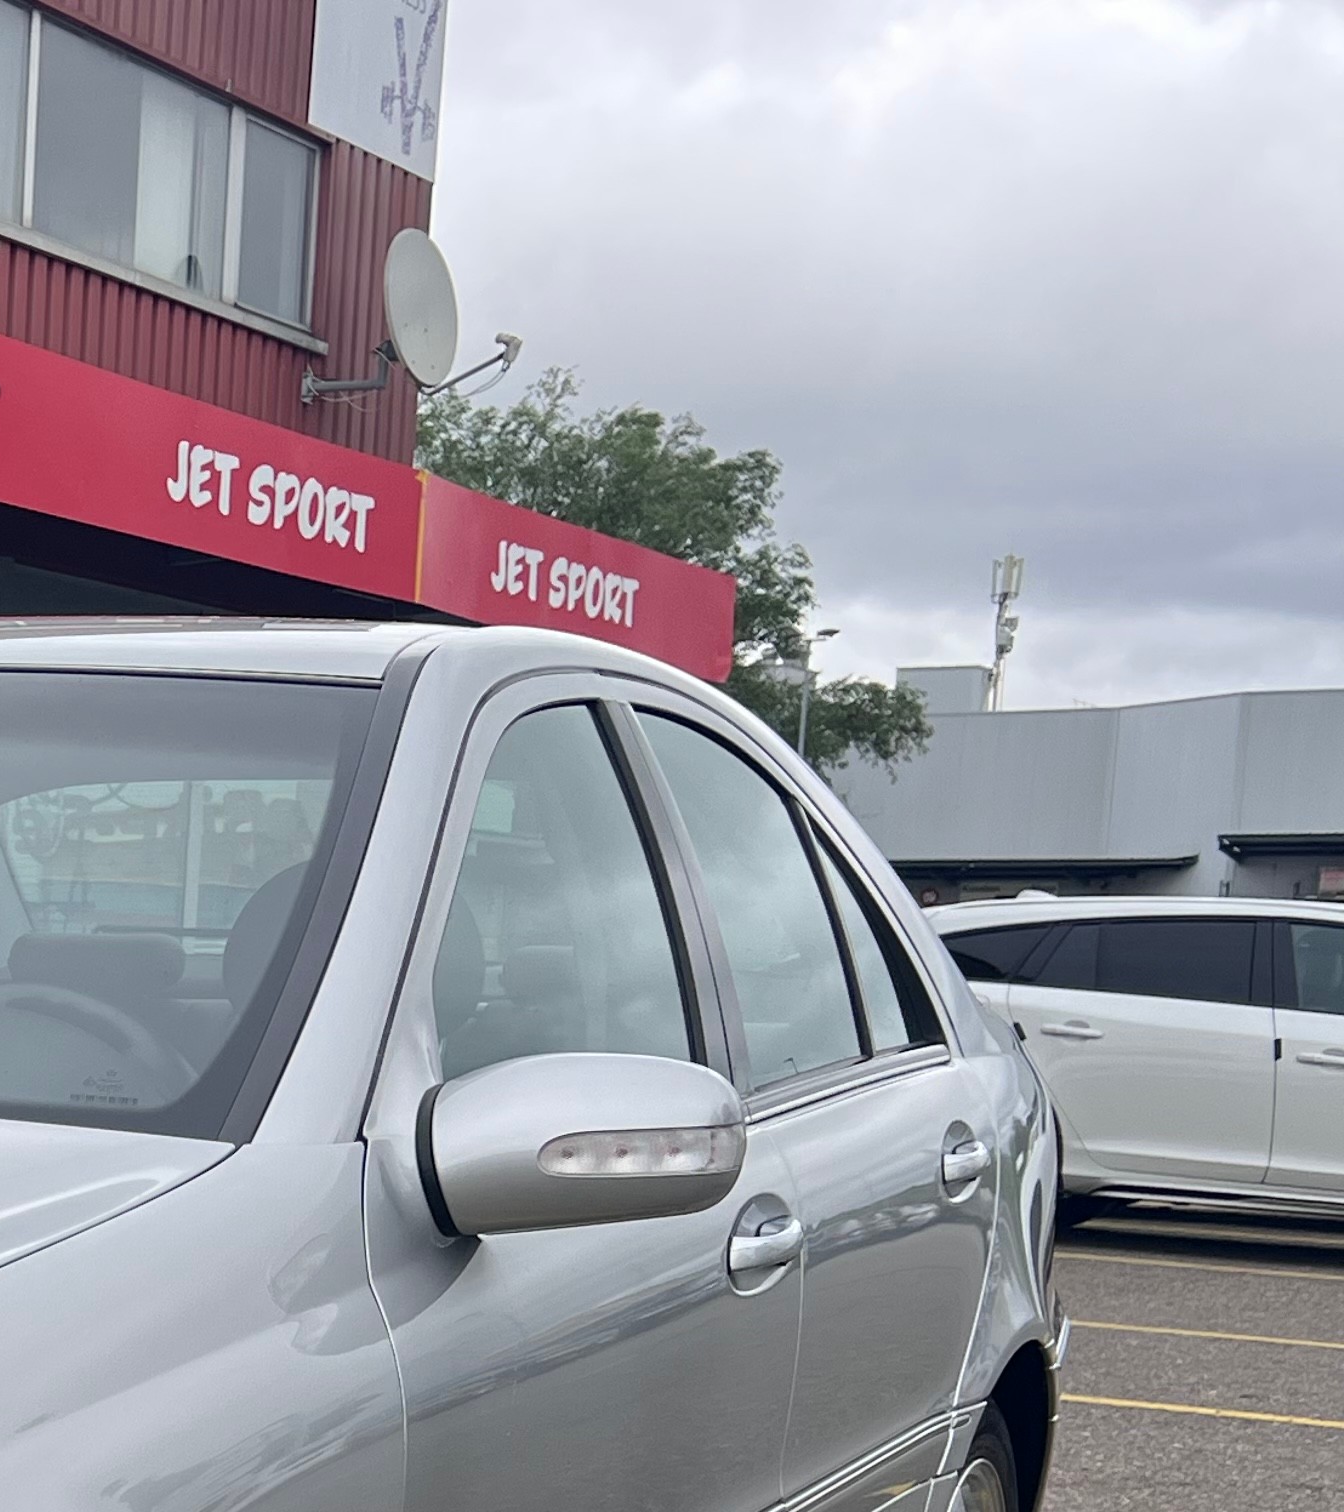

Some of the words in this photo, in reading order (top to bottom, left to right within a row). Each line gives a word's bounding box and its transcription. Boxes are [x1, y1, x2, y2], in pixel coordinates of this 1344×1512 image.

[167, 440, 240, 516] JET
[247, 465, 375, 553] SPORT
[491, 541, 544, 601] JET
[549, 557, 639, 627] SPORT
